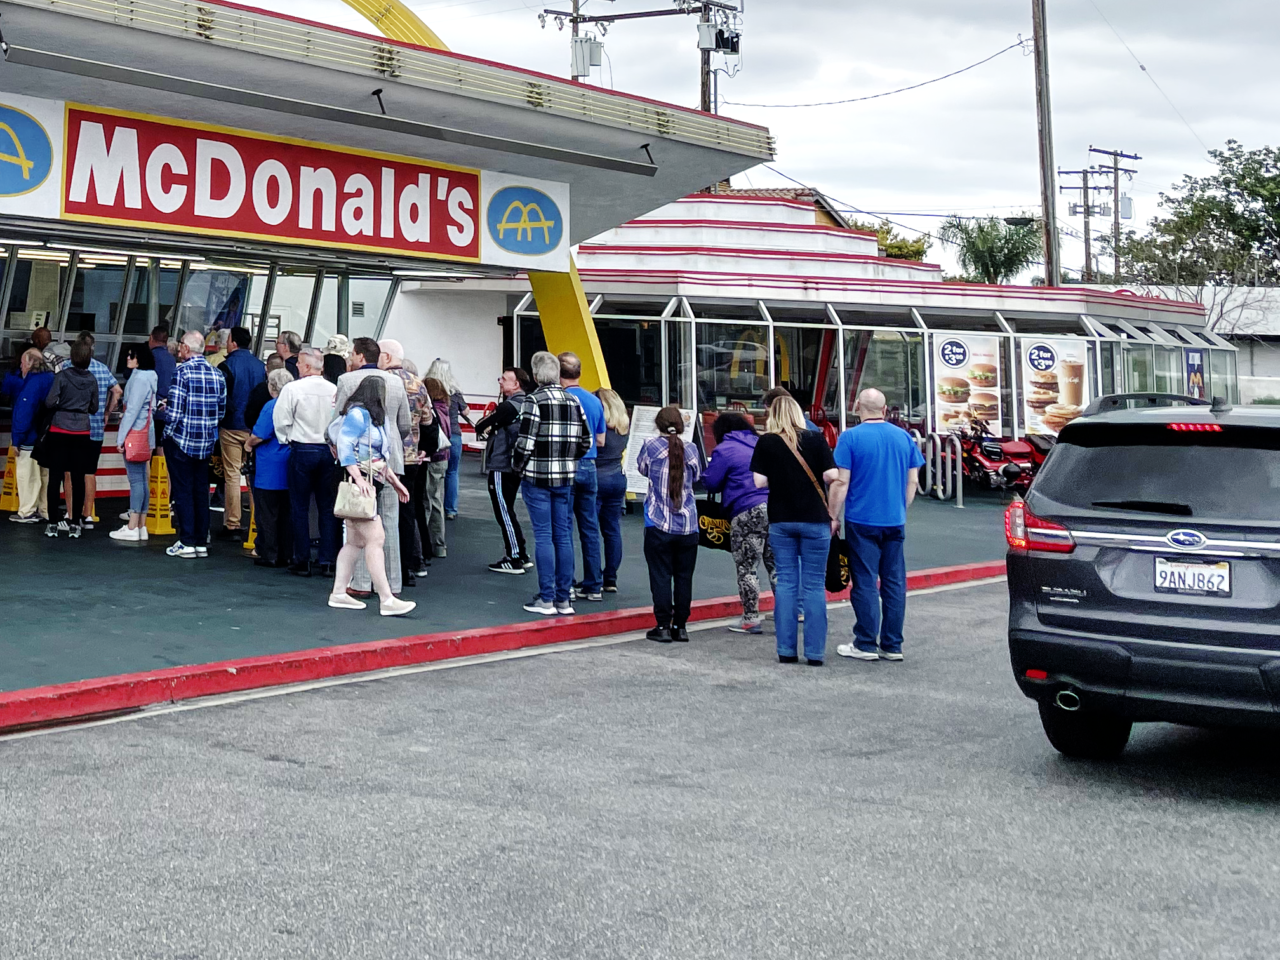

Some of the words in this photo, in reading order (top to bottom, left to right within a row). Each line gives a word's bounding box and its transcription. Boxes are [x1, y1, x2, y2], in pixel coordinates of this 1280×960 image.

[68, 119, 476, 248] McDonald's
[944, 344, 952, 354] 2
[1031, 349, 1039, 360] 2
[1159, 570, 1225, 591] 9ANJ862
